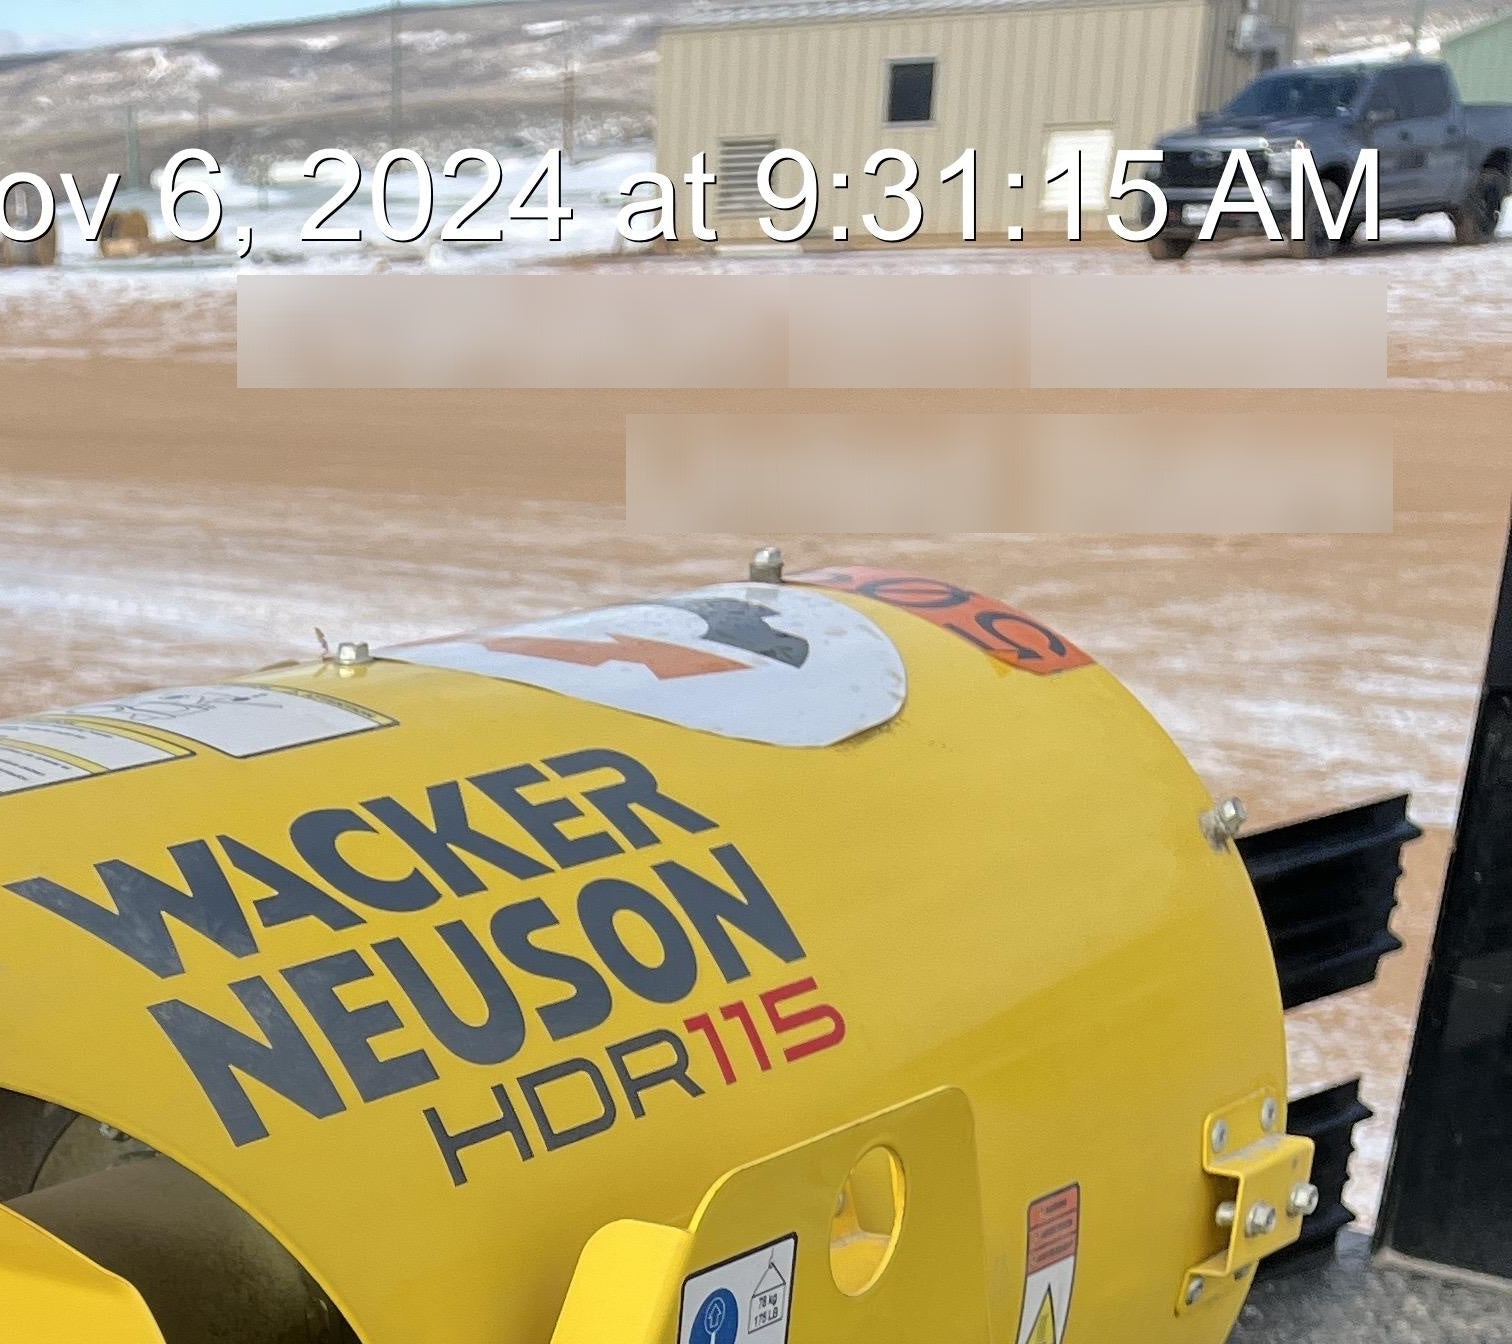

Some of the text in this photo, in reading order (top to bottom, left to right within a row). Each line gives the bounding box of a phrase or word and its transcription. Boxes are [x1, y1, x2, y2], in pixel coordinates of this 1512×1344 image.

[3, 748, 720, 979] WACKER
[147, 843, 808, 1148] NEUSON
[422, 976, 847, 1188] HDR115
